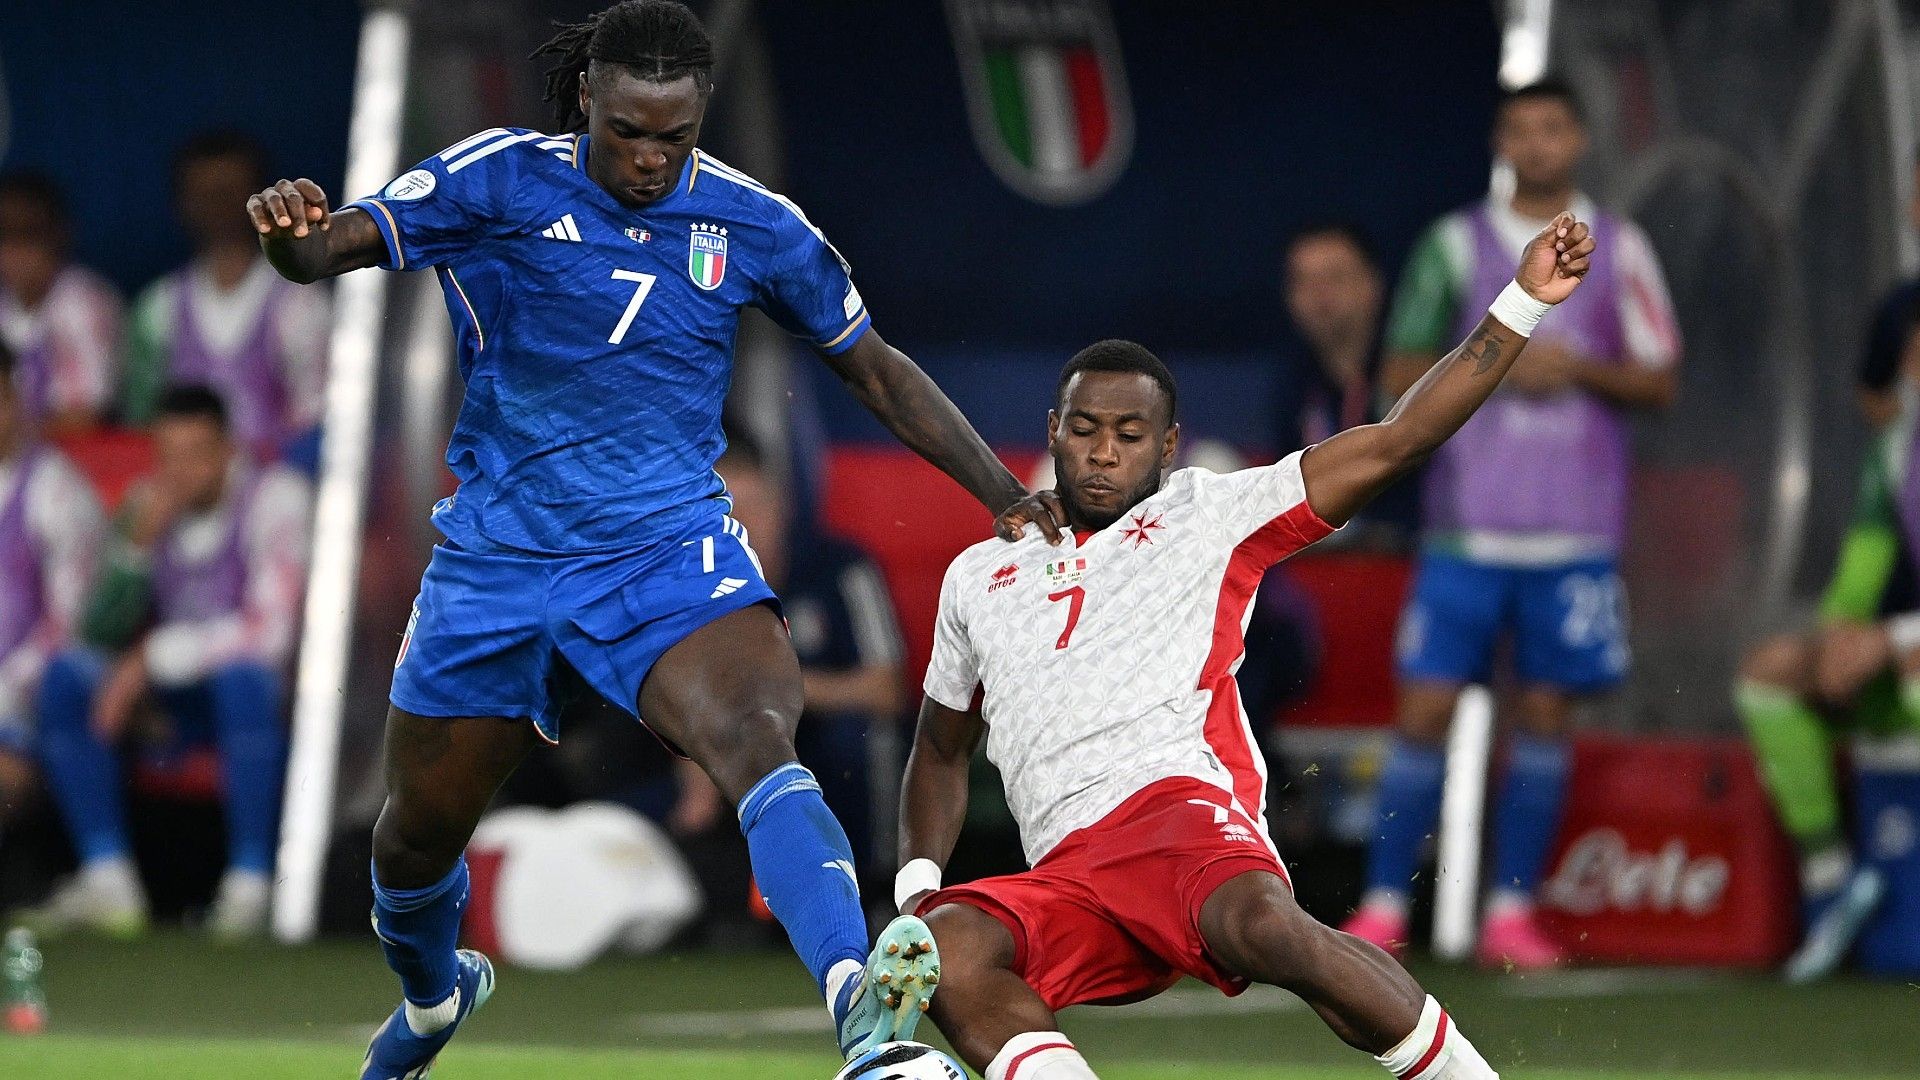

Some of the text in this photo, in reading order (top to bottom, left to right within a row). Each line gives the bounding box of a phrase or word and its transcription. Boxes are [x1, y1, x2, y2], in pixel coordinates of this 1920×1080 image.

[694, 235, 724, 251] ITALIA
[609, 268, 657, 346] 7
[1047, 585, 1086, 650] 7
